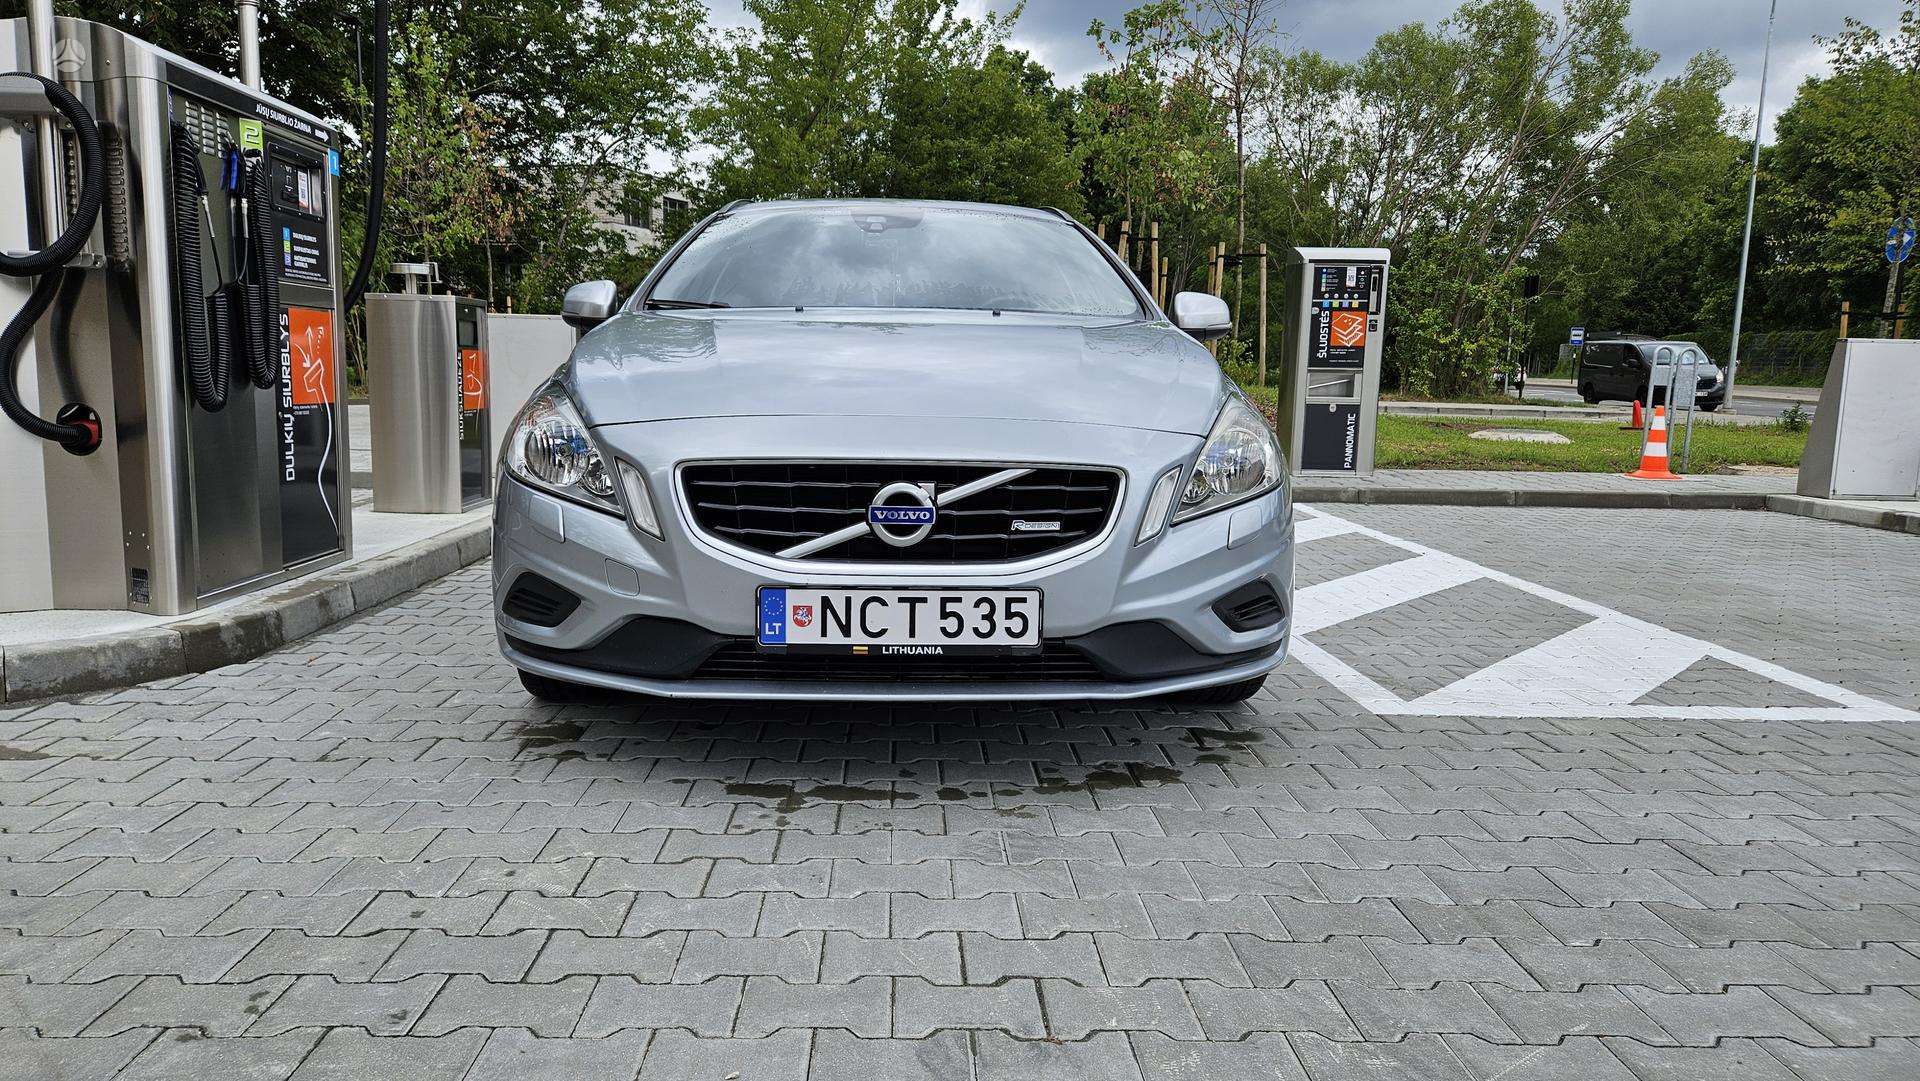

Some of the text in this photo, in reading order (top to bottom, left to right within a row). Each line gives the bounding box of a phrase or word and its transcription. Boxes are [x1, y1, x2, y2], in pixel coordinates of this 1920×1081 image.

[245, 127, 260, 144] 2
[1316, 310, 1330, 359] ŠLUOSTĖS
[279, 313, 295, 482] DULKIŲ SIURBLYS
[1344, 413, 1356, 469] PANNOMATIC
[874, 510, 930, 520] VOLVO
[765, 622, 782, 635] LT
[820, 595, 1029, 639] NCT 535
[882, 646, 944, 655] LITHUANIA
